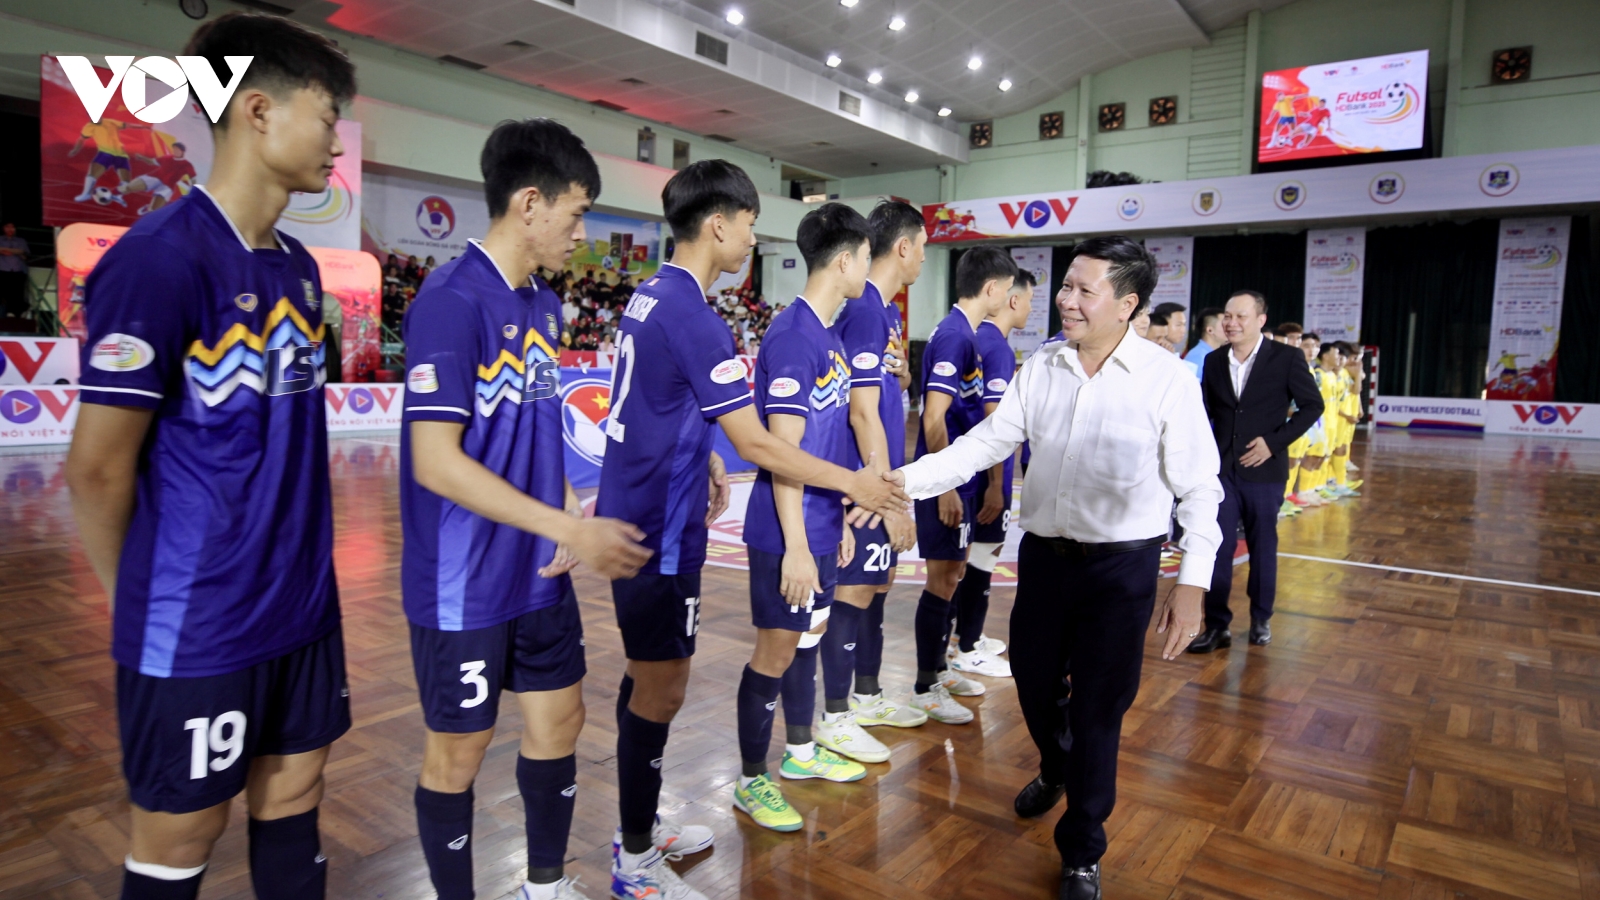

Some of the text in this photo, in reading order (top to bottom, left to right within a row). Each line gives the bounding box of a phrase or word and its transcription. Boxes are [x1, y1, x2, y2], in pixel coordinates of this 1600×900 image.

[1336, 88, 1383, 104] Futsal
[999, 197, 1079, 229] VOV
[0, 389, 80, 425] OV
[325, 387, 398, 415] VOV
[1391, 405, 1482, 417] VIETNAMESEFOOTBALL
[1512, 404, 1584, 426] VOV
[863, 542, 892, 572] 20
[459, 660, 489, 709] 3
[184, 710, 248, 780] 19
